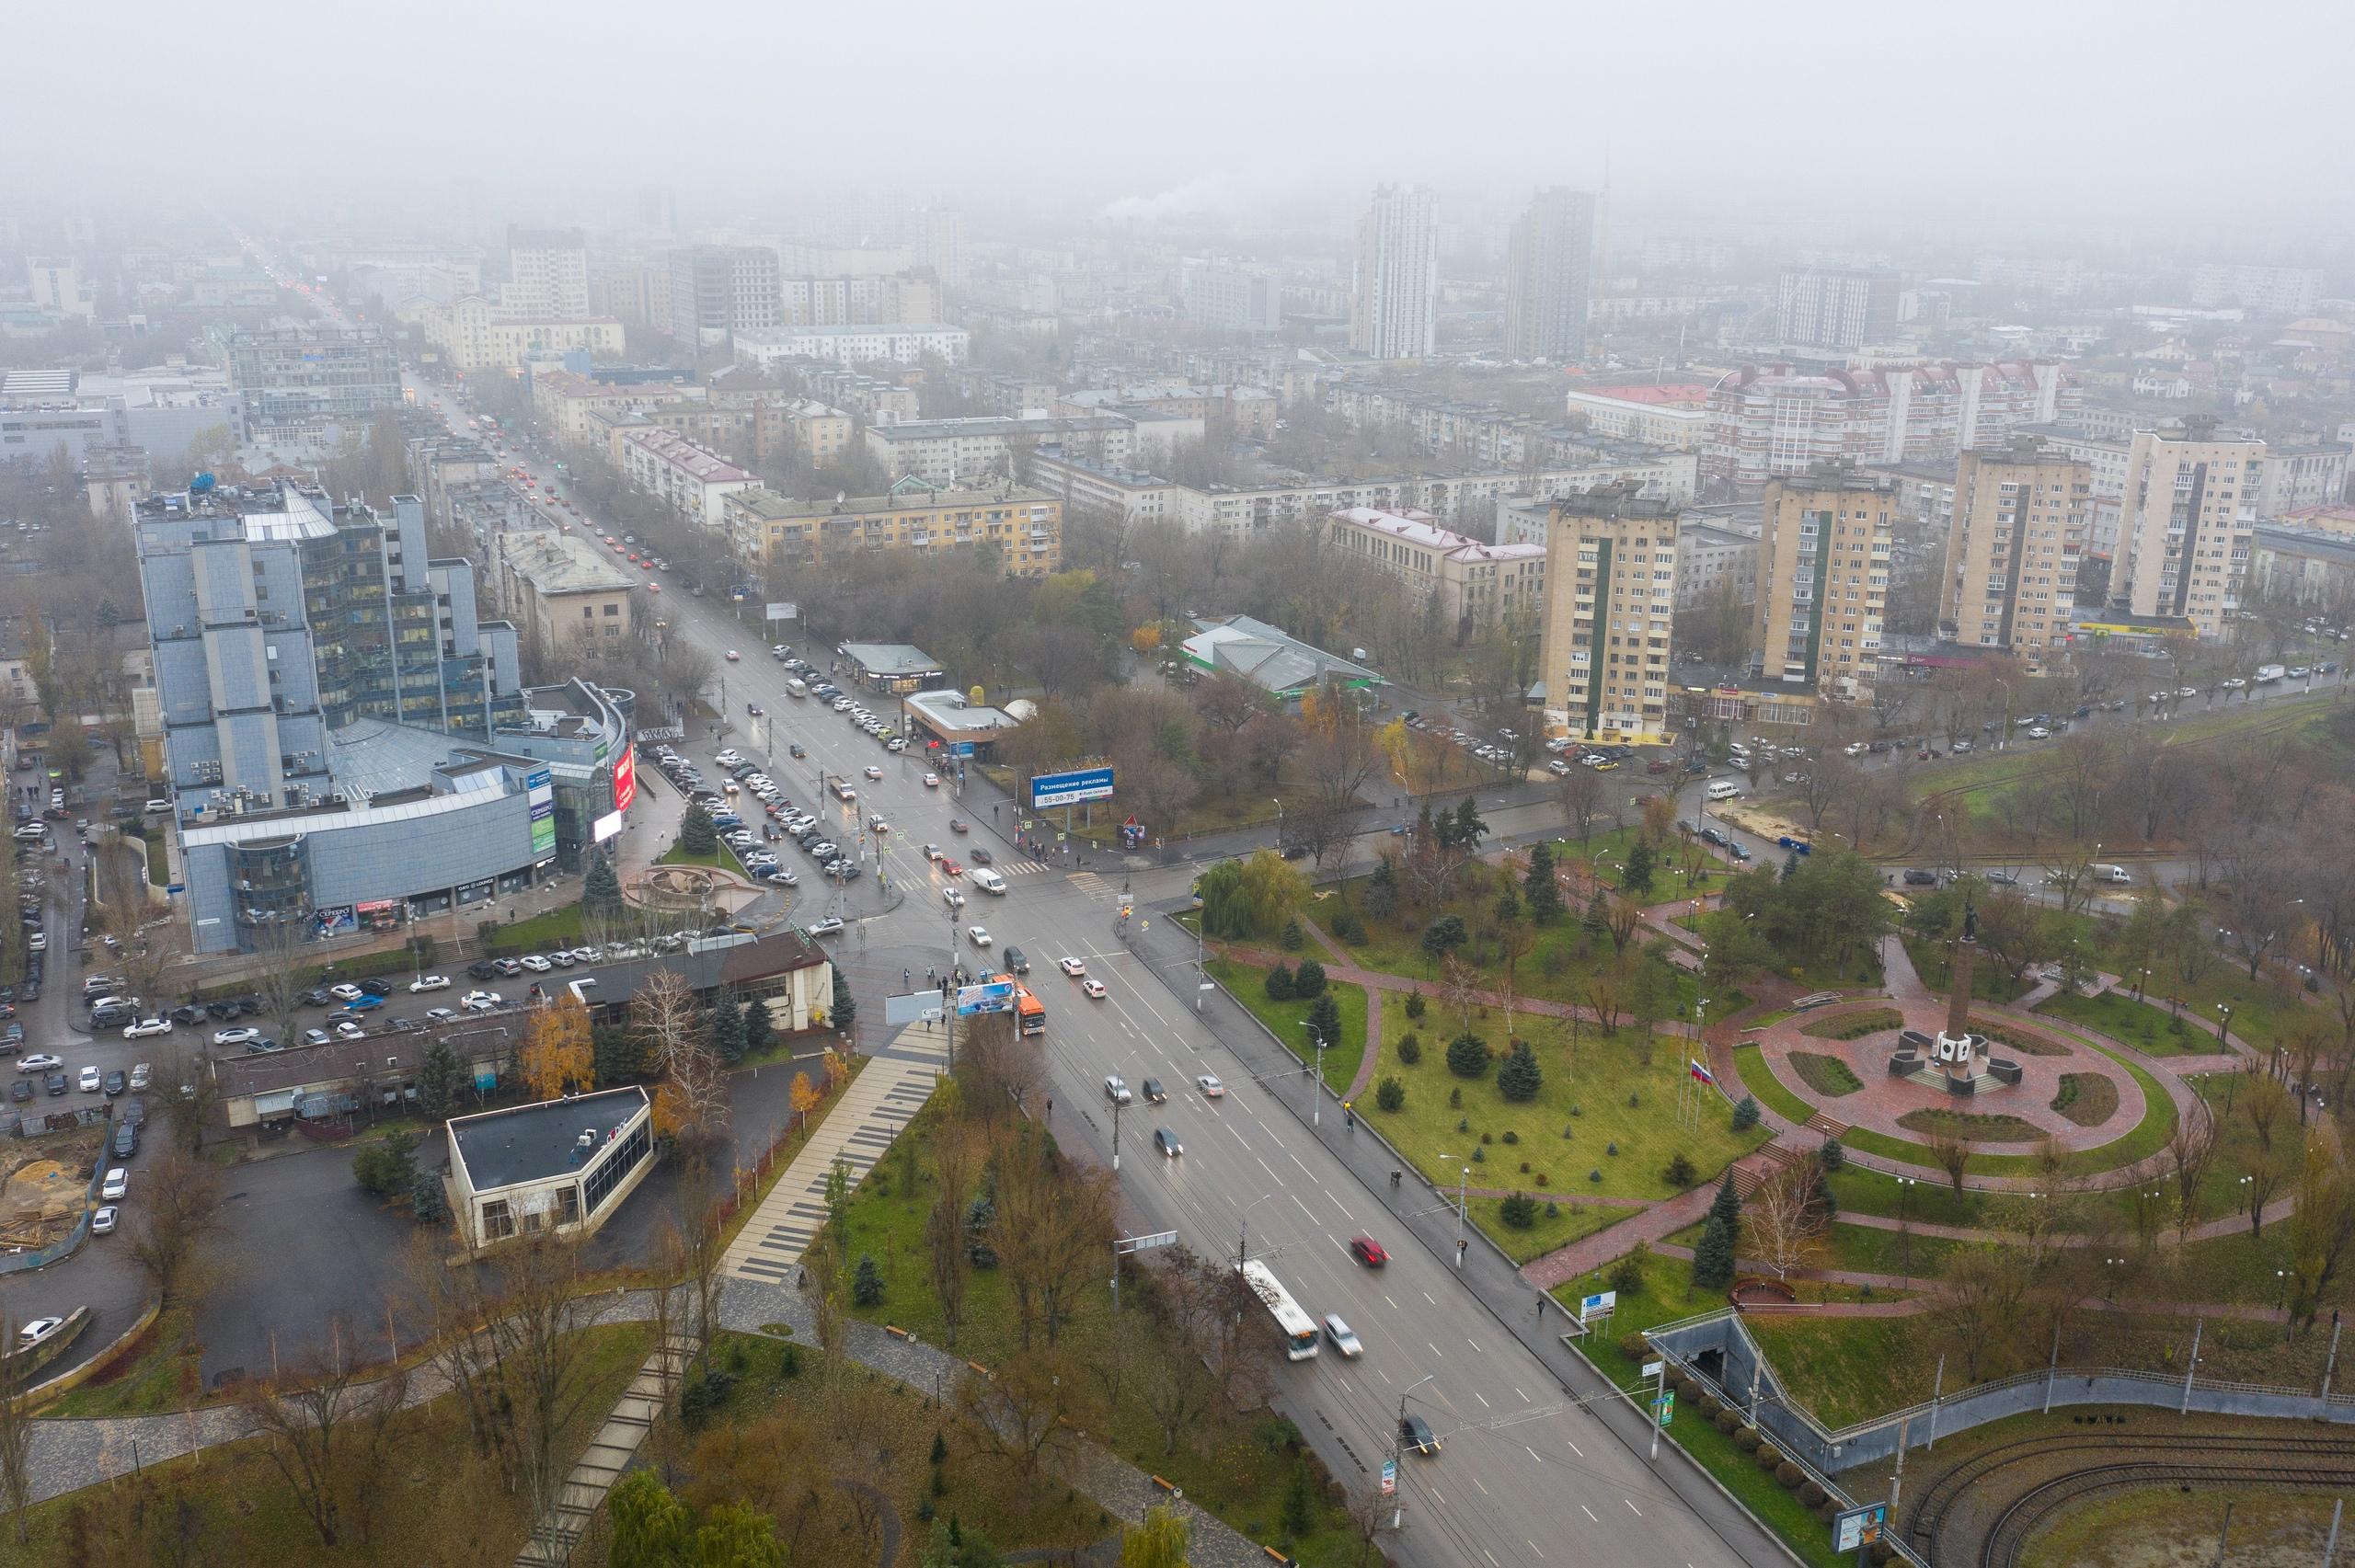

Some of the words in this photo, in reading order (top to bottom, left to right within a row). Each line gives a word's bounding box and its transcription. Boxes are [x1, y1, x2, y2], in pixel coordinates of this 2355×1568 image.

[1040, 782, 1079, 791] Размещение
[1082, 778, 1108, 786] рекламы
[1045, 793, 1074, 803] 55-00-75
